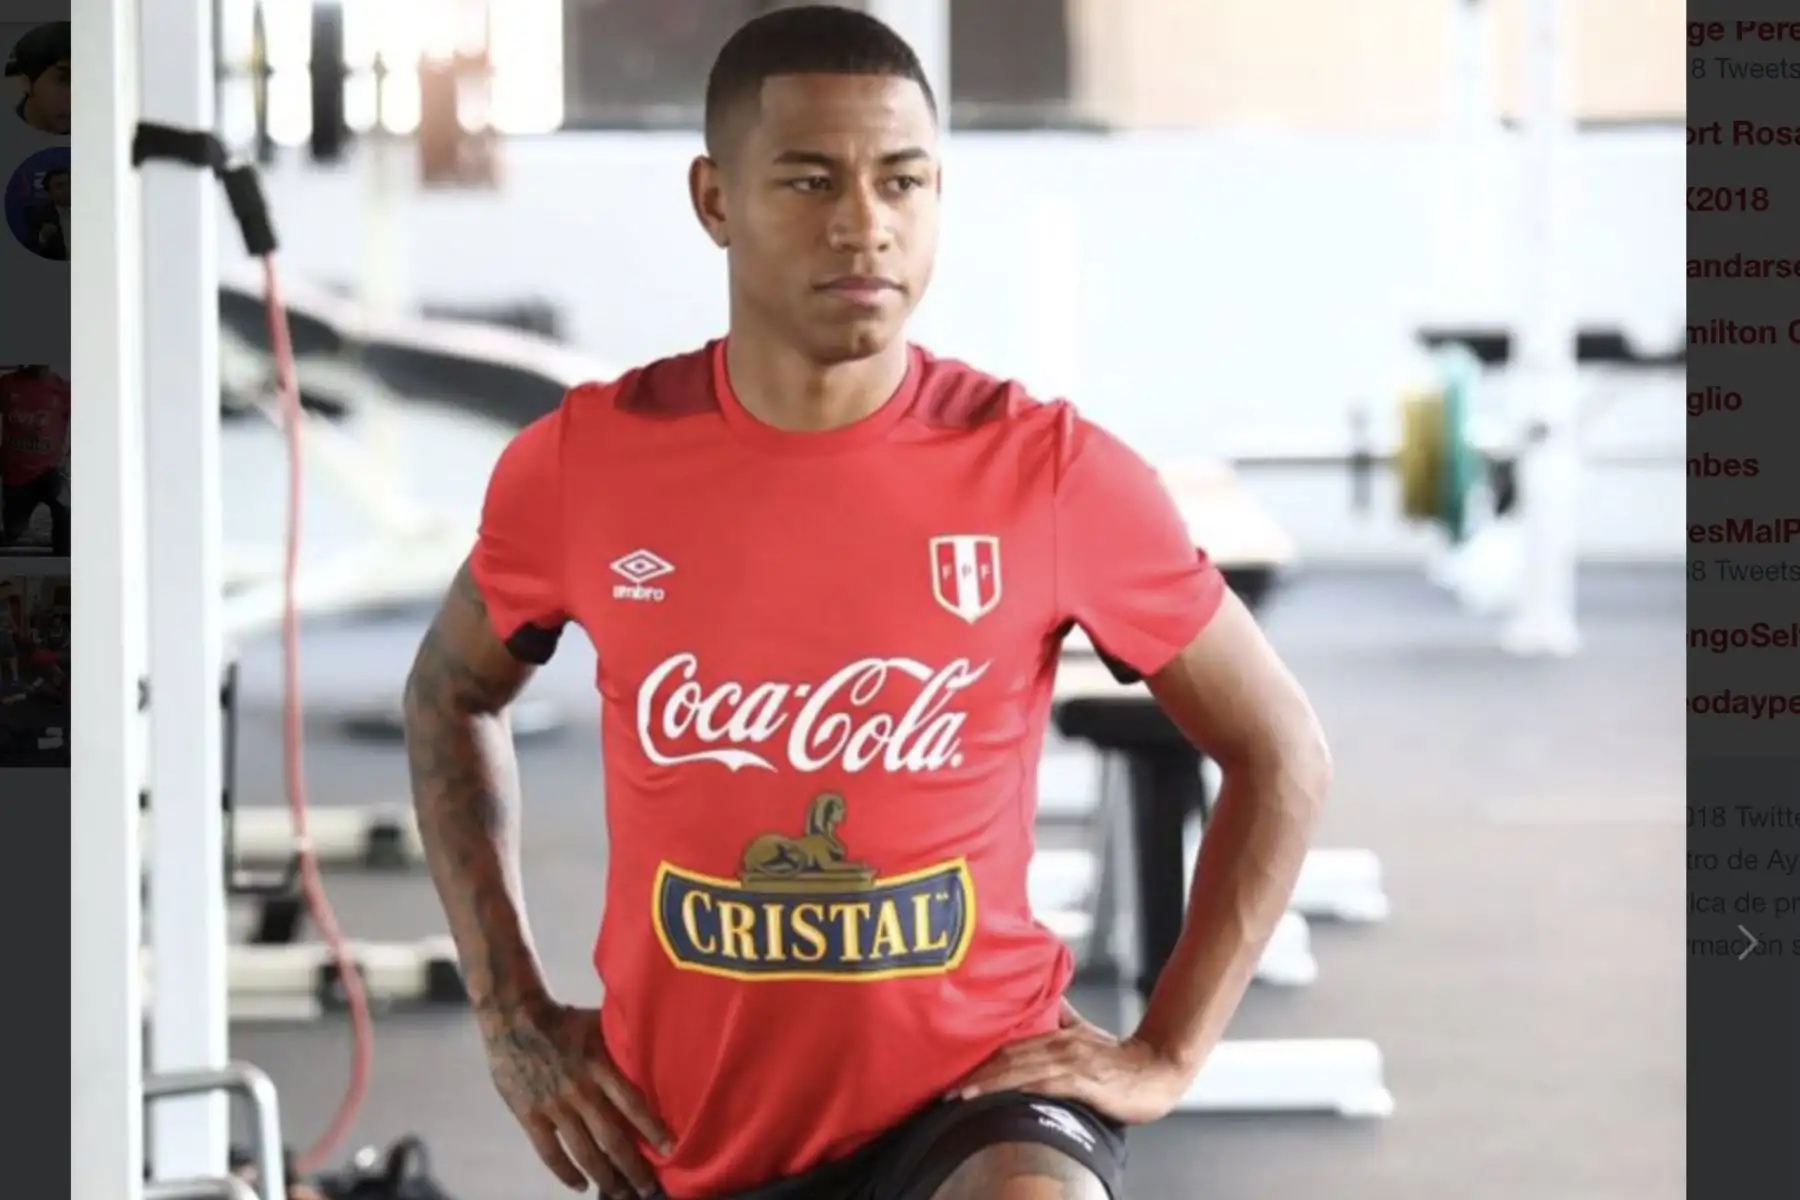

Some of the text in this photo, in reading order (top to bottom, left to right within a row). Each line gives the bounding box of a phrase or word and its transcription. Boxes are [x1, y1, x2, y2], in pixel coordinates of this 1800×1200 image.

[1713, 57, 1800, 80] Tweets
[1687, 386, 1743, 417] glio
[1687, 518, 1800, 543] esMalP
[1687, 558, 1800, 582] 8 Tweets
[1687, 622, 1800, 653] ngoSel
[1687, 688, 1800, 720] odaype
[1727, 848, 1758, 871] de
[1734, 891, 1766, 914] de
[682, 890, 948, 961] CRISTAL
